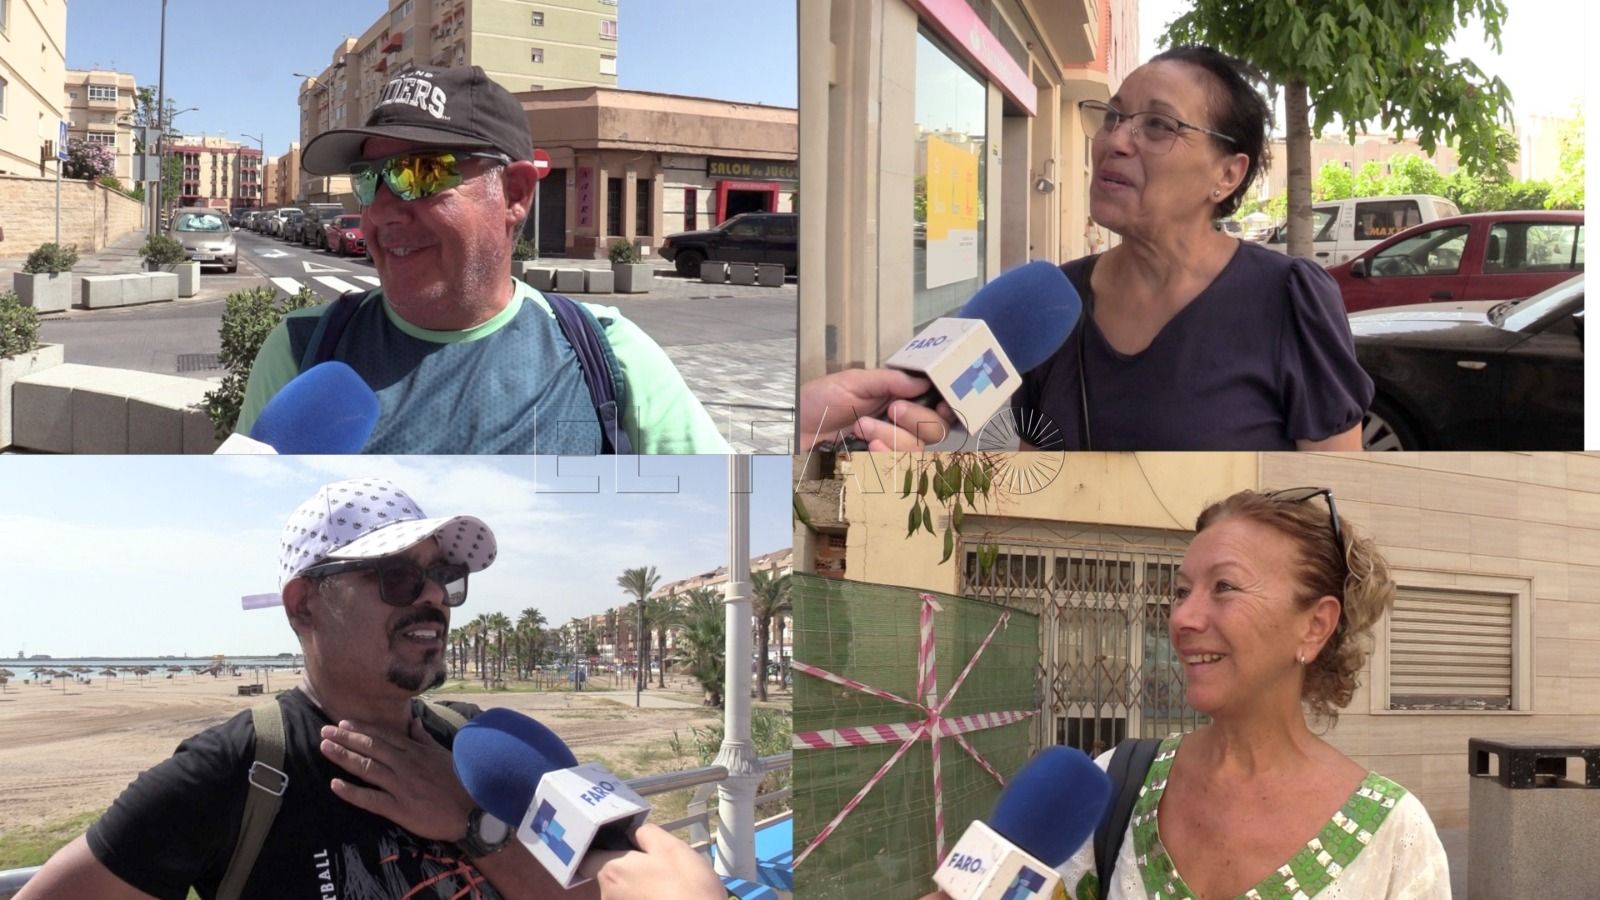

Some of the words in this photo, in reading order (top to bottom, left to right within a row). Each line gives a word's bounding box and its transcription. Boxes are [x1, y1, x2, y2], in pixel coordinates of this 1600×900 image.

[376, 77, 447, 119] DERS
[905, 335, 948, 351] FARO
[580, 781, 616, 807] FARO
[947, 853, 983, 873] FARO
